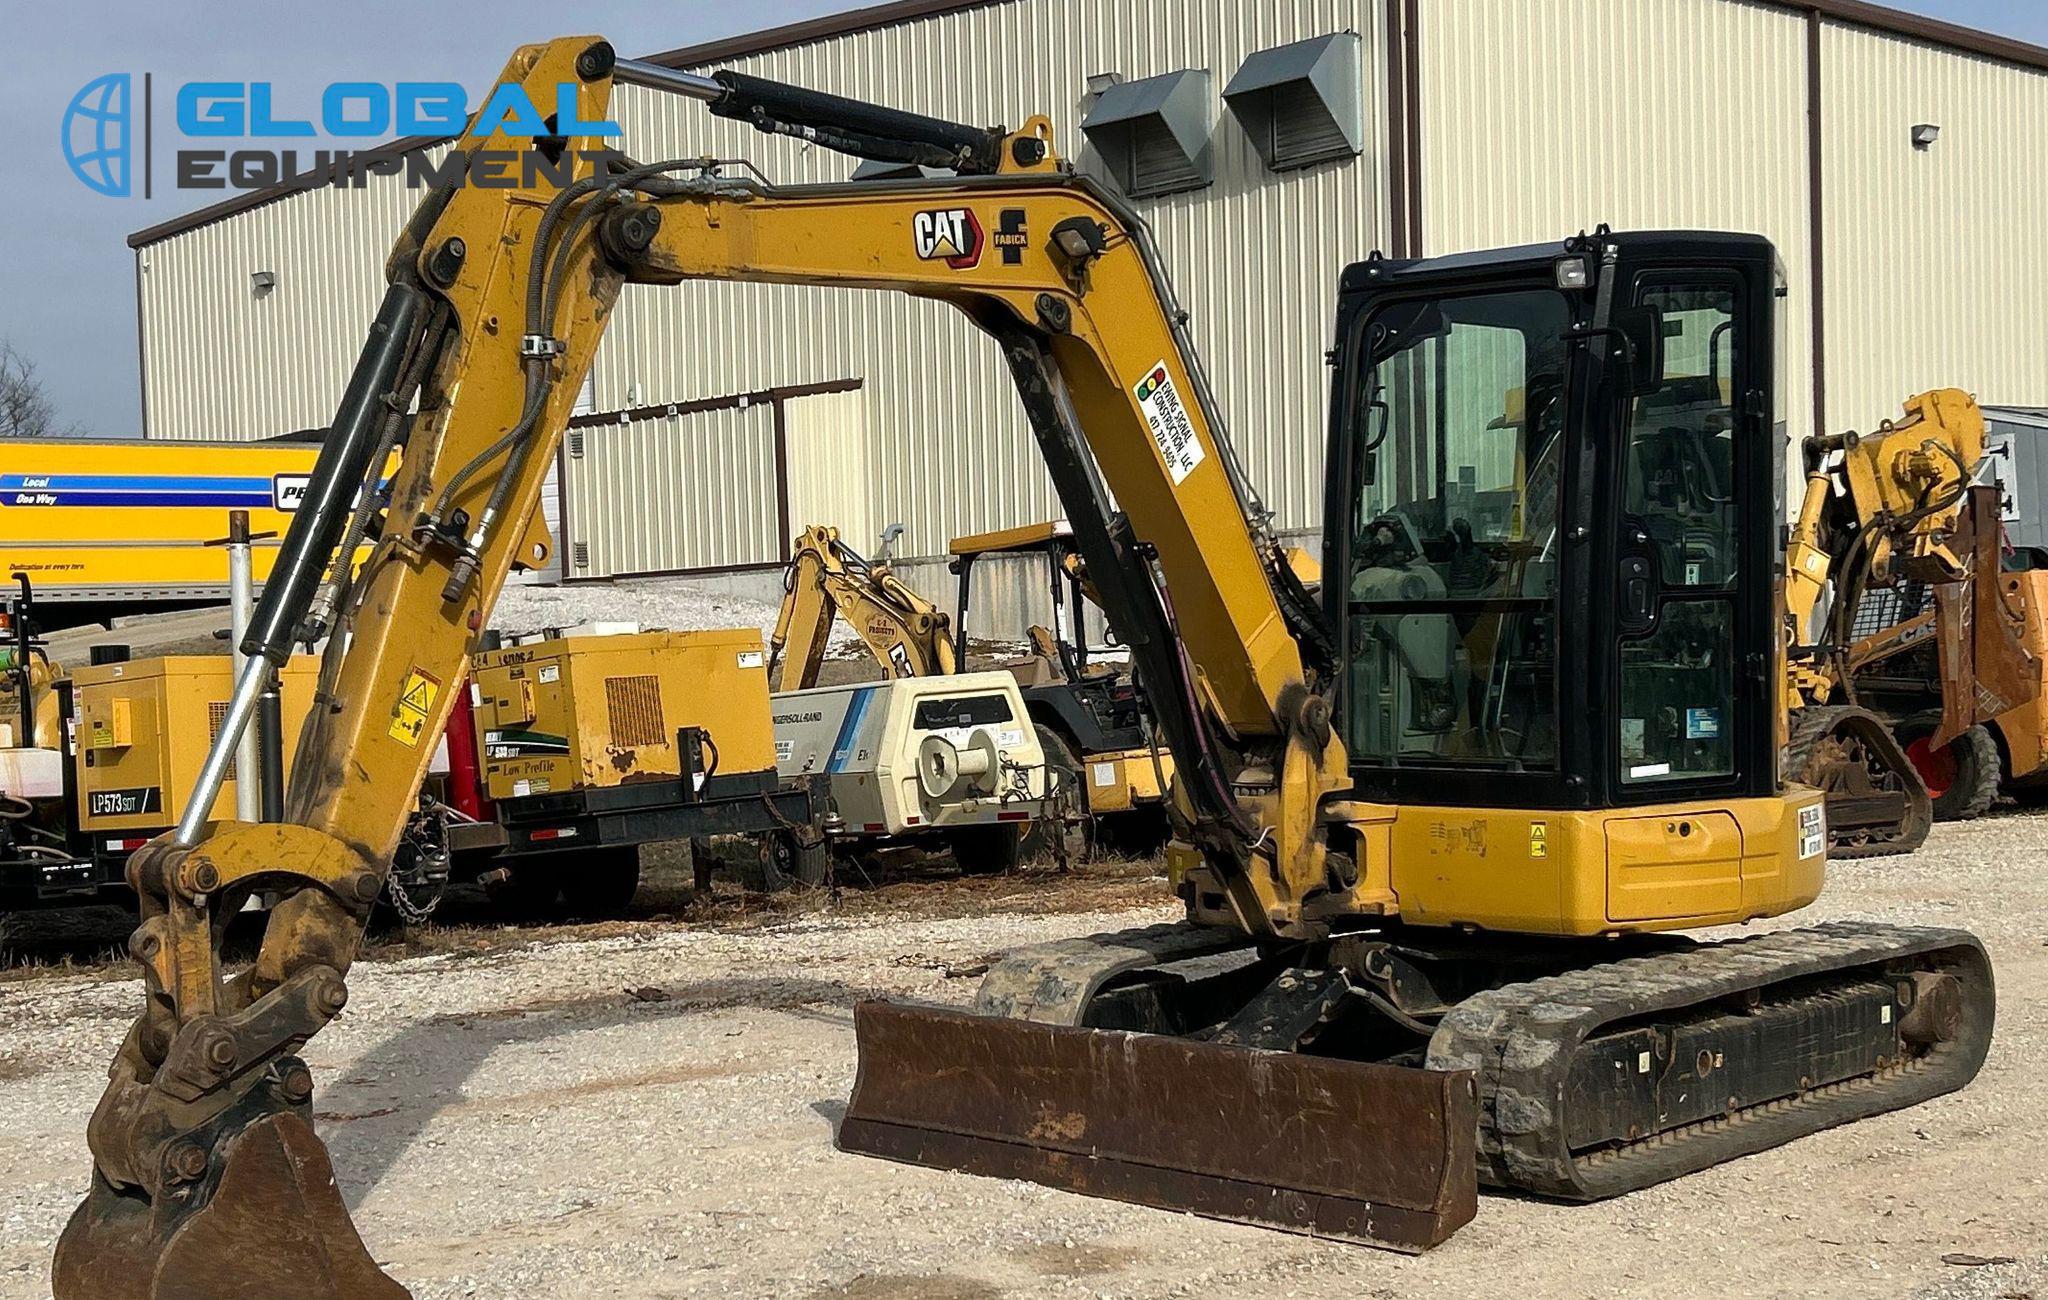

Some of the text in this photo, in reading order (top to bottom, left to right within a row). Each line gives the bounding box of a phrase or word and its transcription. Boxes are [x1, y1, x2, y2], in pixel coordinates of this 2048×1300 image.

[914, 209, 965, 258] CAT
[995, 234, 1027, 245] FABICK
[1161, 381, 1193, 444] EWING SIGNAL
[1149, 415, 1160, 430] 417
[1155, 429, 1167, 447] 724
[1180, 452, 1193, 471] LLC
[22, 477, 50, 488] Local
[16, 493, 58, 505] One Way
[503, 759, 555, 777] Low Profile
